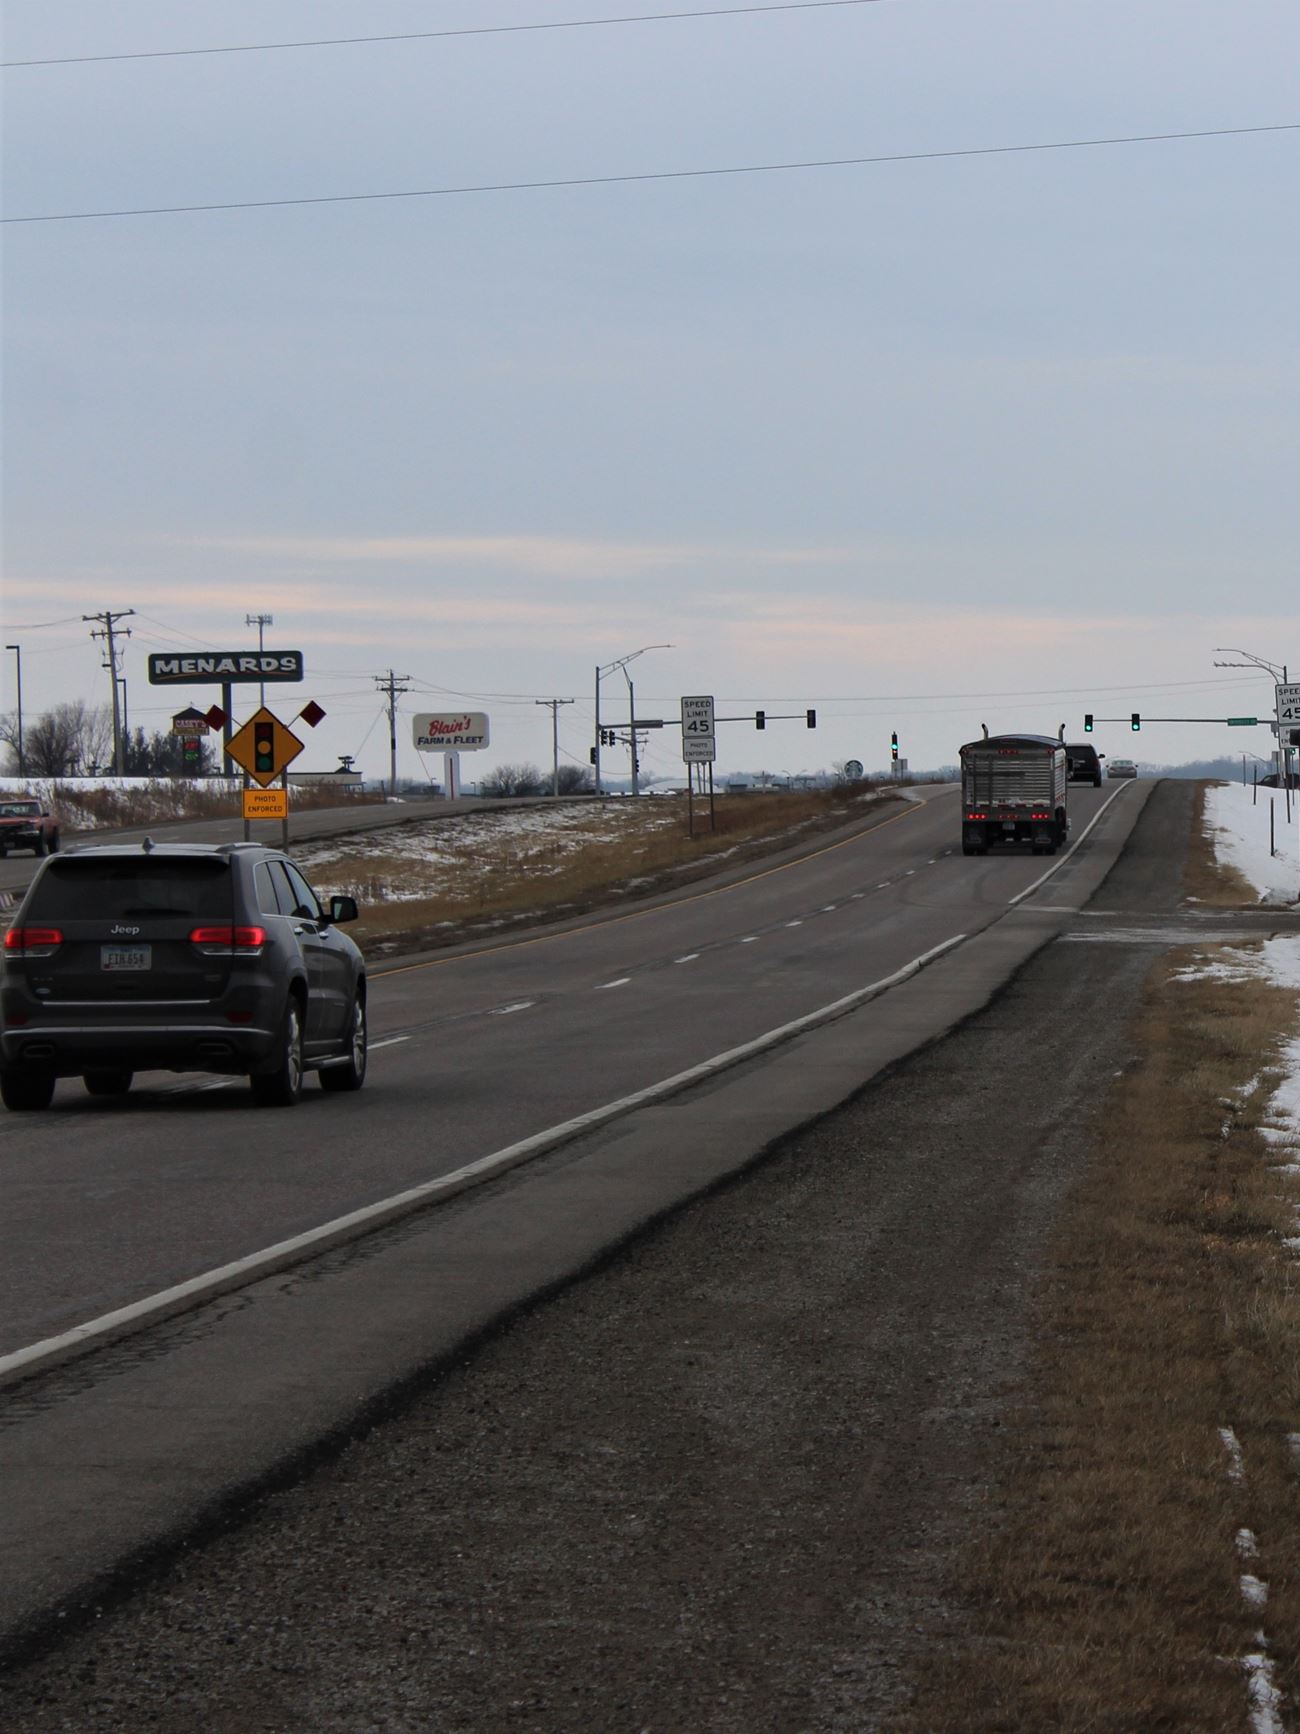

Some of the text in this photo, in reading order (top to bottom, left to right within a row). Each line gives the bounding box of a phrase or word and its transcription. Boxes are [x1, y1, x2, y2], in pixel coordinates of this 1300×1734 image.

[154, 657, 298, 674] MENARDS
[684, 700, 712, 709] SPEED
[687, 710, 708, 718] LIMIT
[428, 715, 472, 737] Blain's
[687, 720, 709, 732] 45
[417, 736, 444, 745] FARM
[453, 735, 484, 744] FLEET
[254, 795, 277, 803] PHOTO
[247, 805, 283, 813] ENFORCED
[110, 924, 140, 935] Jeep
